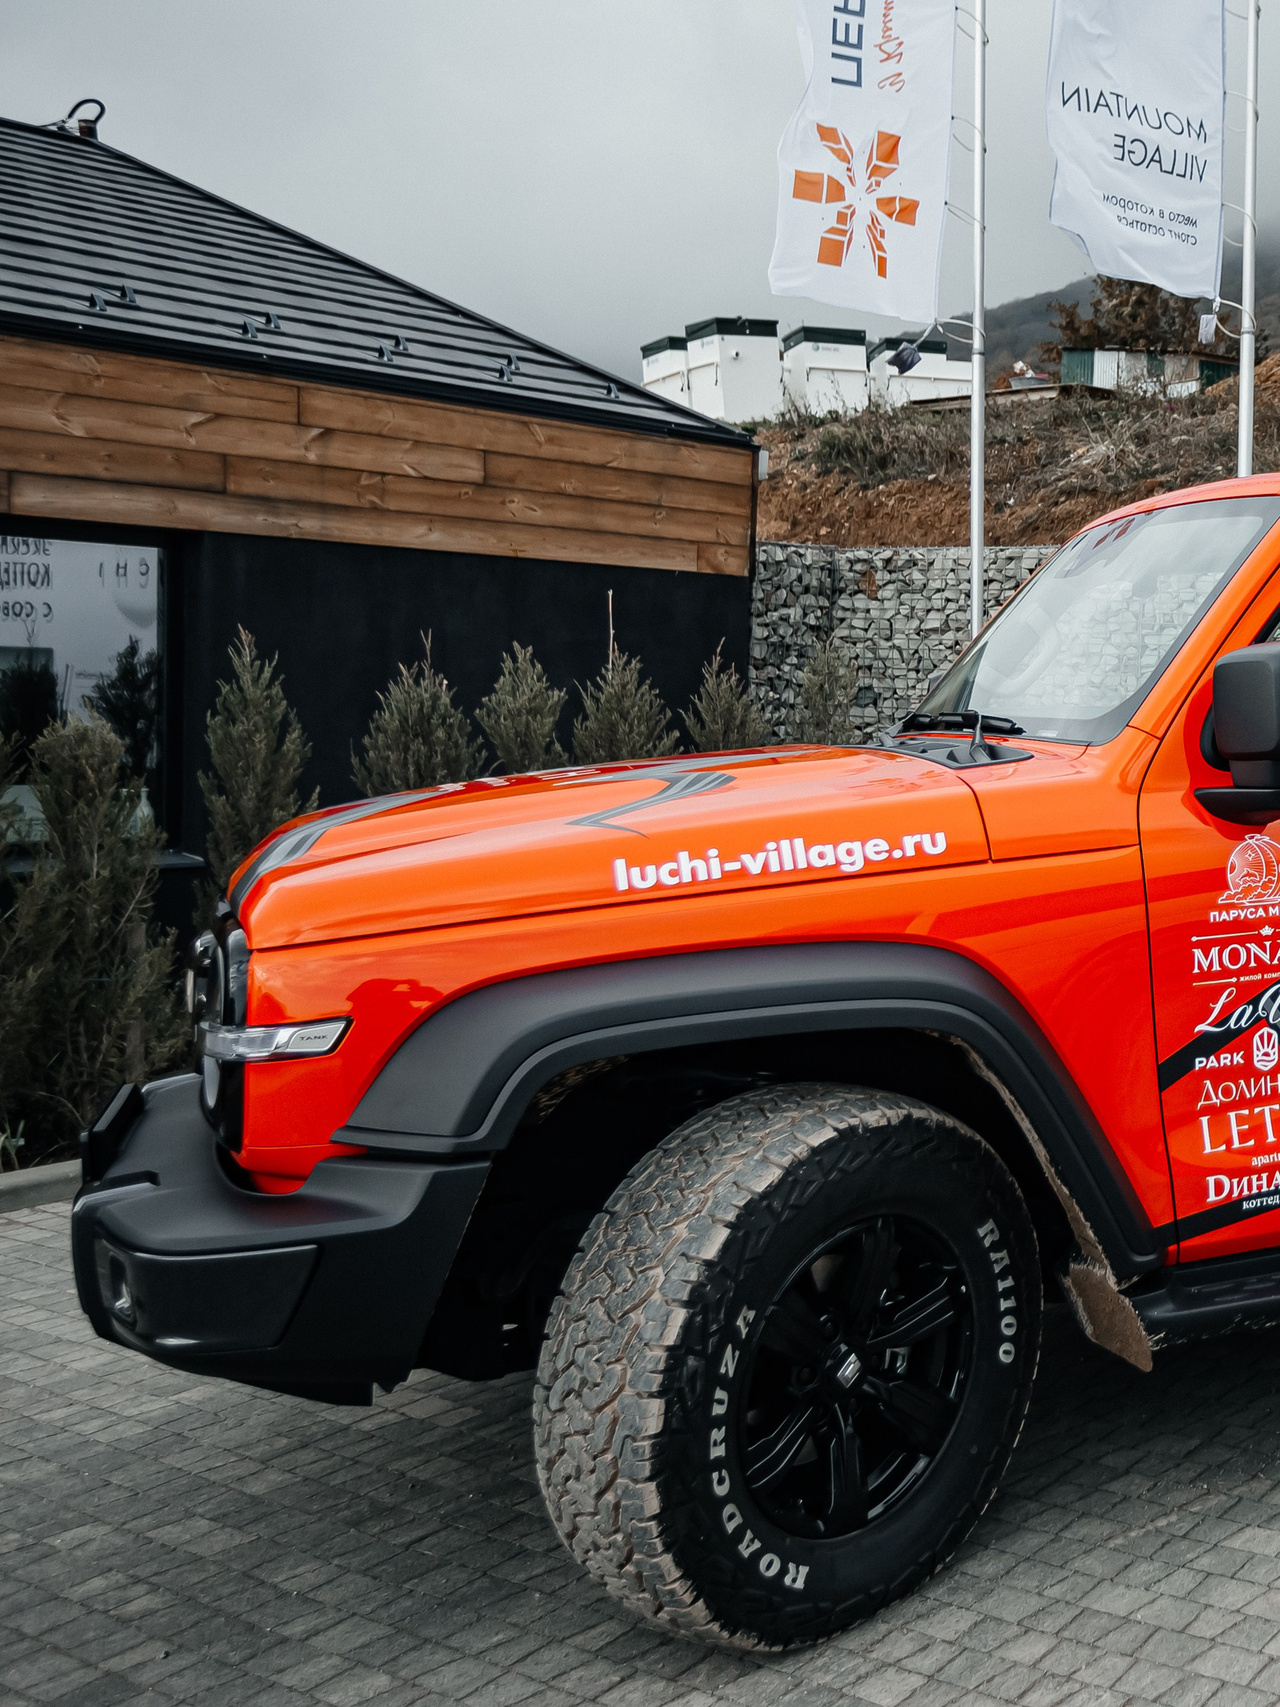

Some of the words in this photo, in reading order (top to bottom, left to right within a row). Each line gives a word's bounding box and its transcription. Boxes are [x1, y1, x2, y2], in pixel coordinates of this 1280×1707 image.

[613, 832, 946, 891] luchi-village.ru
[1209, 907, 1266, 923] ПАРУСА
[1195, 1051, 1245, 1071] PARK
[709, 1304, 812, 1590] ROADCRUZA
